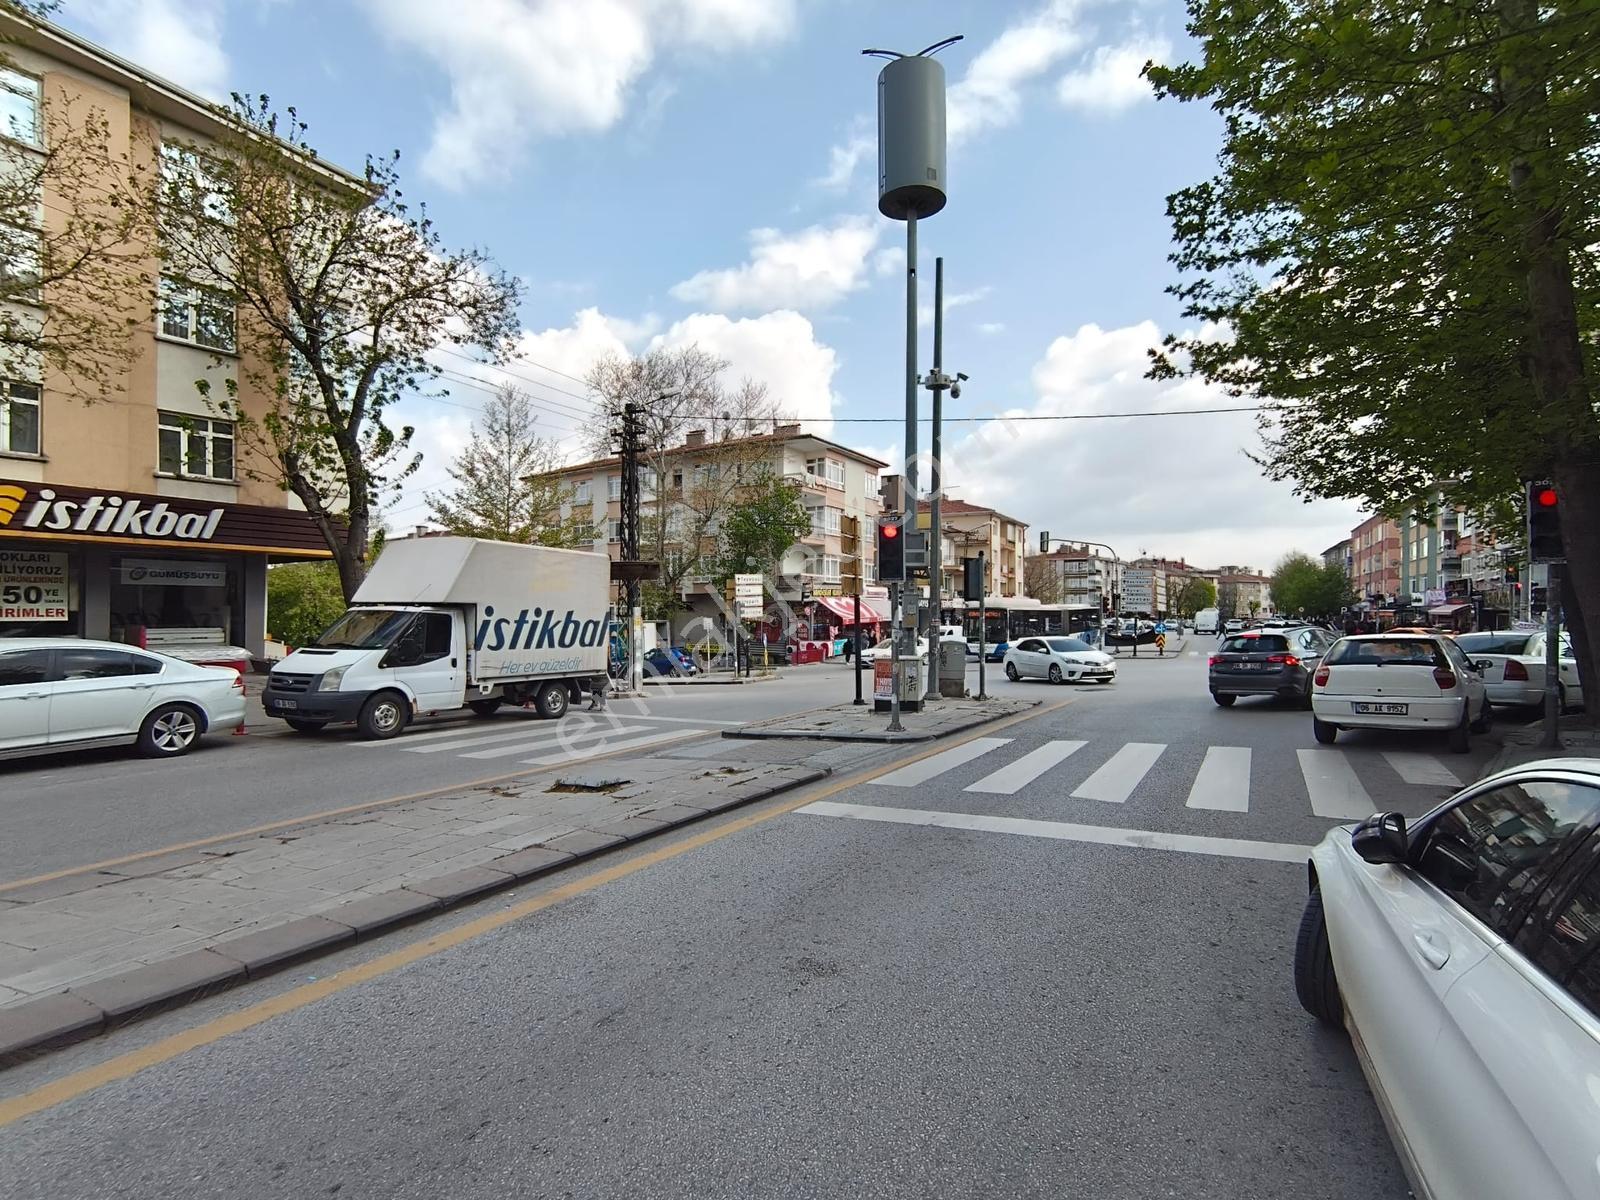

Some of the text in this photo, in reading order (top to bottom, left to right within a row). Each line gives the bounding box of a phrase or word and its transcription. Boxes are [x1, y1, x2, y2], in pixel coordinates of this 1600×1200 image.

[24, 488, 225, 540] istikbal
[2, 585, 43, 604] 50
[474, 605, 611, 652] istikbal
[500, 656, 582, 675] Her ev güzeldir
